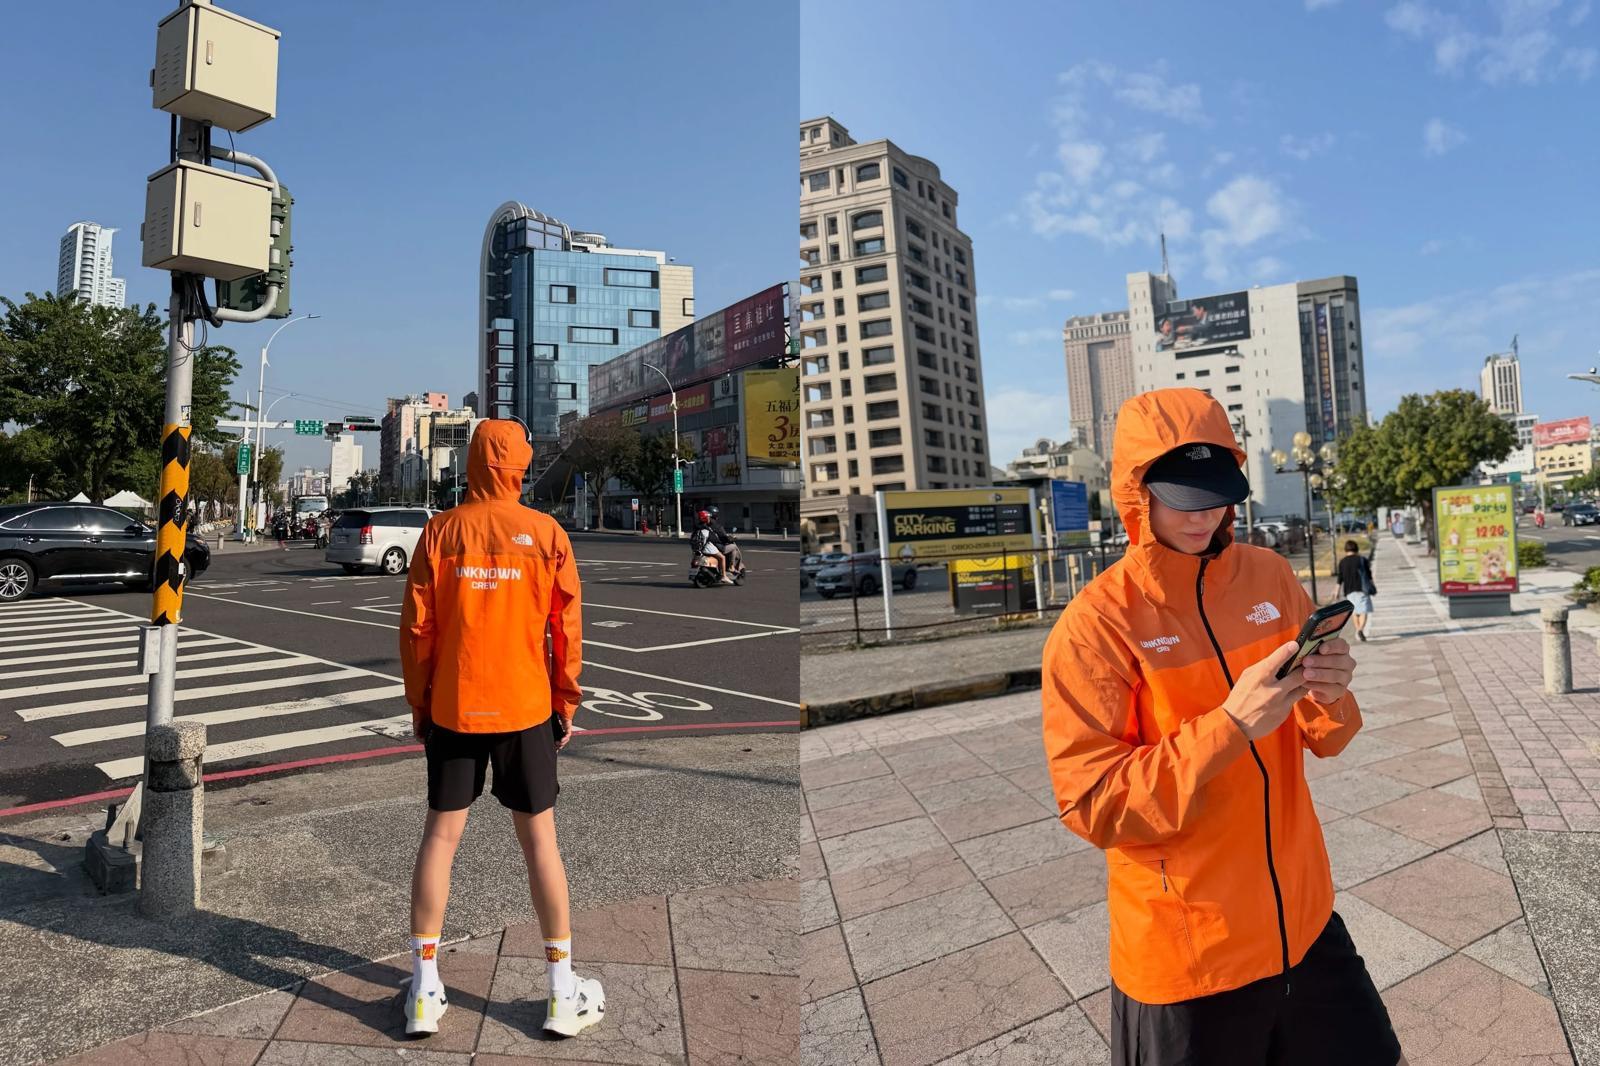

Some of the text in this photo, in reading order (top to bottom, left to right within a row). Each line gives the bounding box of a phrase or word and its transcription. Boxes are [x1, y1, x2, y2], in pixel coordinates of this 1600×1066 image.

[1473, 503, 1507, 514] Party
[894, 513, 925, 525] CITY
[895, 522, 956, 536] PARKING
[456, 567, 521, 580] UNKNOWN
[471, 581, 498, 590] CREW
[1245, 609, 1271, 623] NORTH
[1255, 616, 1273, 626] FACE
[1140, 635, 1181, 649] UNKNOWN
